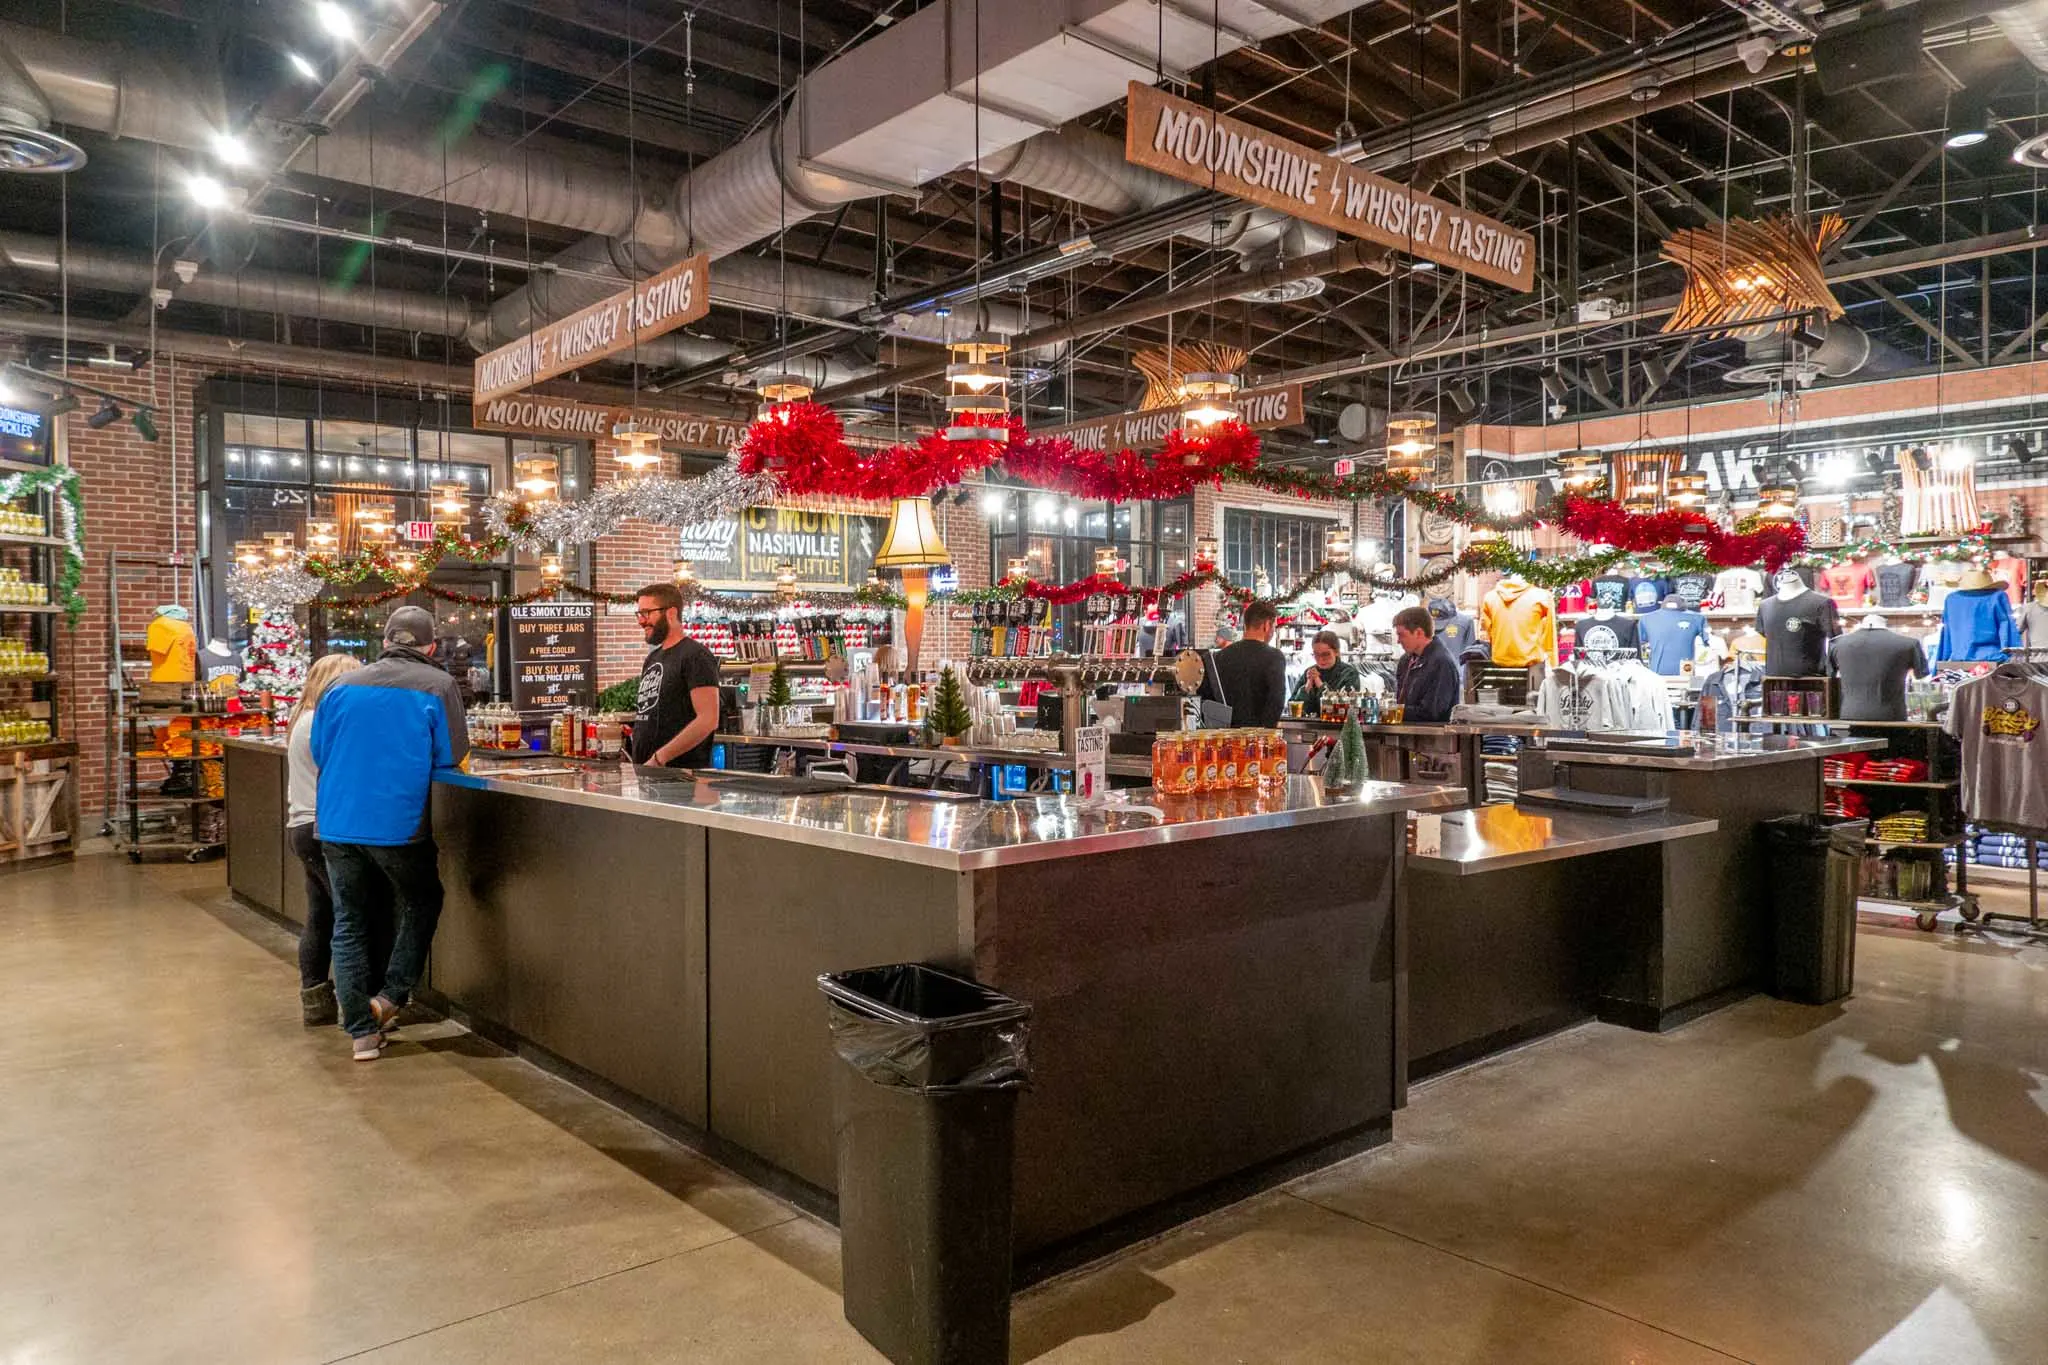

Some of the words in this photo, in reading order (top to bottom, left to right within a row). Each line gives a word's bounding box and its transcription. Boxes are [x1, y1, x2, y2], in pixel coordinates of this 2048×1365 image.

[1153, 105, 1321, 205] MOONSHINE
[1344, 175, 1442, 245] WHISKEY
[1448, 215, 1526, 275] TASTING
[480, 337, 548, 393] MOONSHINE
[559, 303, 622, 362] WHISKEY
[626, 269, 693, 333] TASTING
[1236, 391, 1288, 423] STING
[485, 400, 609, 434] MOONSHINE
[411, 522, 432, 539] EXIT
[750, 533, 840, 557] NASHVILLE
[750, 555, 777, 574] LIVE
[797, 559, 840, 576] LITTLE
[511, 606, 528, 617] OLE
[530, 606, 562, 617] SMOKY
[564, 606, 592, 616] DEALS
[519, 624, 538, 633] BUY
[538, 623, 563, 633] THREE
[565, 623, 585, 633] JARS
[530, 647, 535, 655] A
[552, 646, 576, 654] COOLER
[526, 666, 542, 675] BUY
[545, 665, 559, 675] SIX
[560, 664, 581, 674] JARS
[521, 675, 533, 683] FOR
[535, 674, 545, 682] THE
[546, 674, 562, 682] PRICE
[564, 673, 570, 681] OF
[572, 673, 584, 681] FIVE
[537, 696, 551, 704] FREE
[553, 695, 568, 703] COOL
[1078, 736, 1103, 752] TASTING
